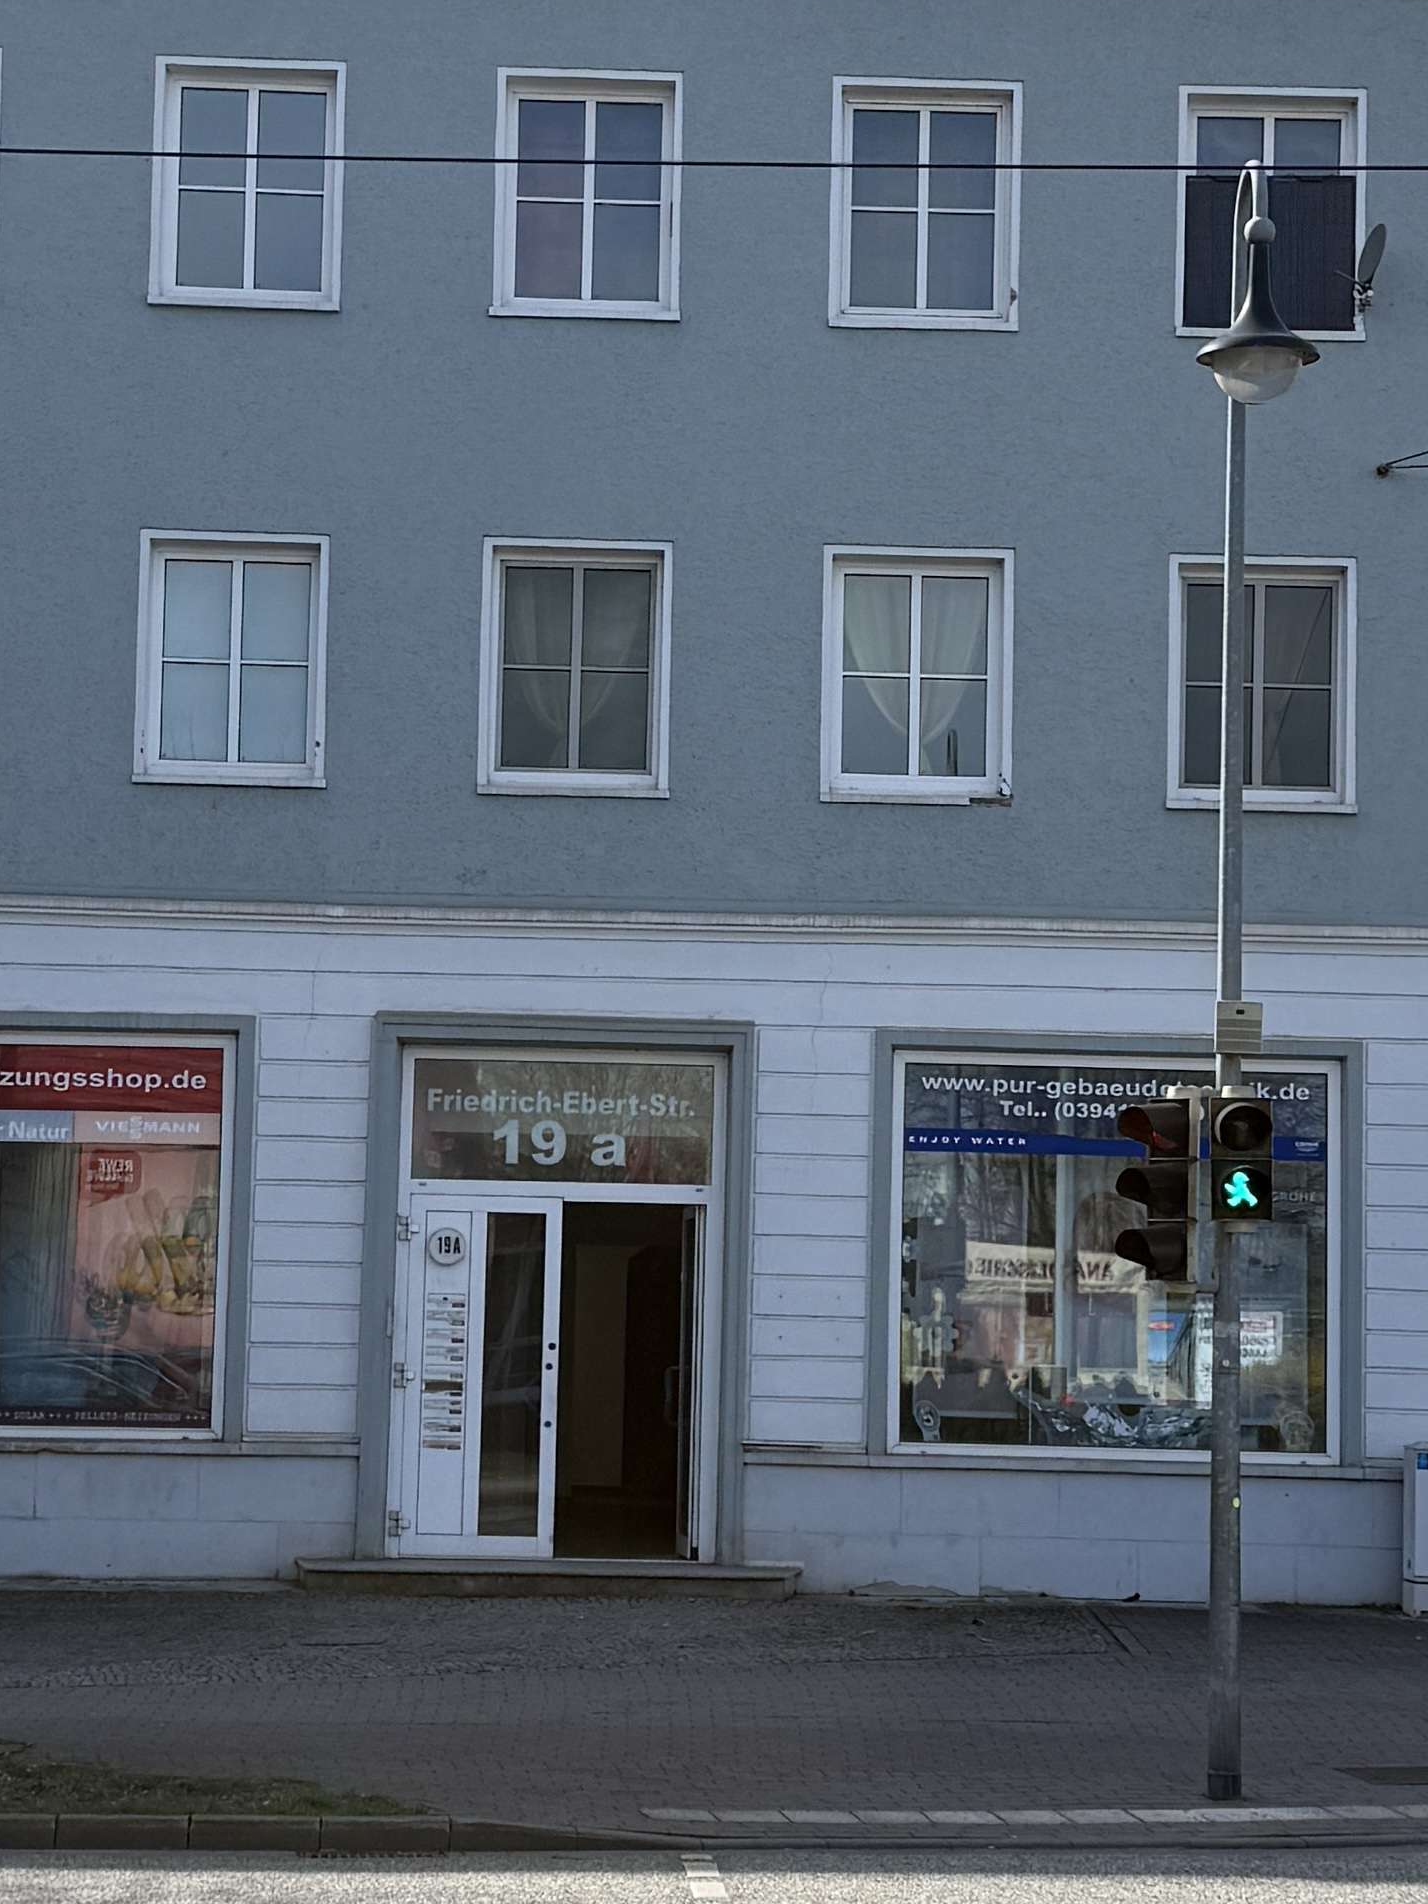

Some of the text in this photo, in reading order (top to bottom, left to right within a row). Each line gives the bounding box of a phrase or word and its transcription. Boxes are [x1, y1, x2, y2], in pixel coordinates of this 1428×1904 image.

[922, 1076, 1310, 1100] www.pur-gebaeudk.de
[427, 1087, 695, 1117] Friedrich-Ebert-Str.
[8, 1120, 70, 1141] Natur
[908, 1136, 1026, 1146] ENJOY WATER
[492, 1119, 626, 1167] 19 a
[438, 1236, 461, 1254] 19A
